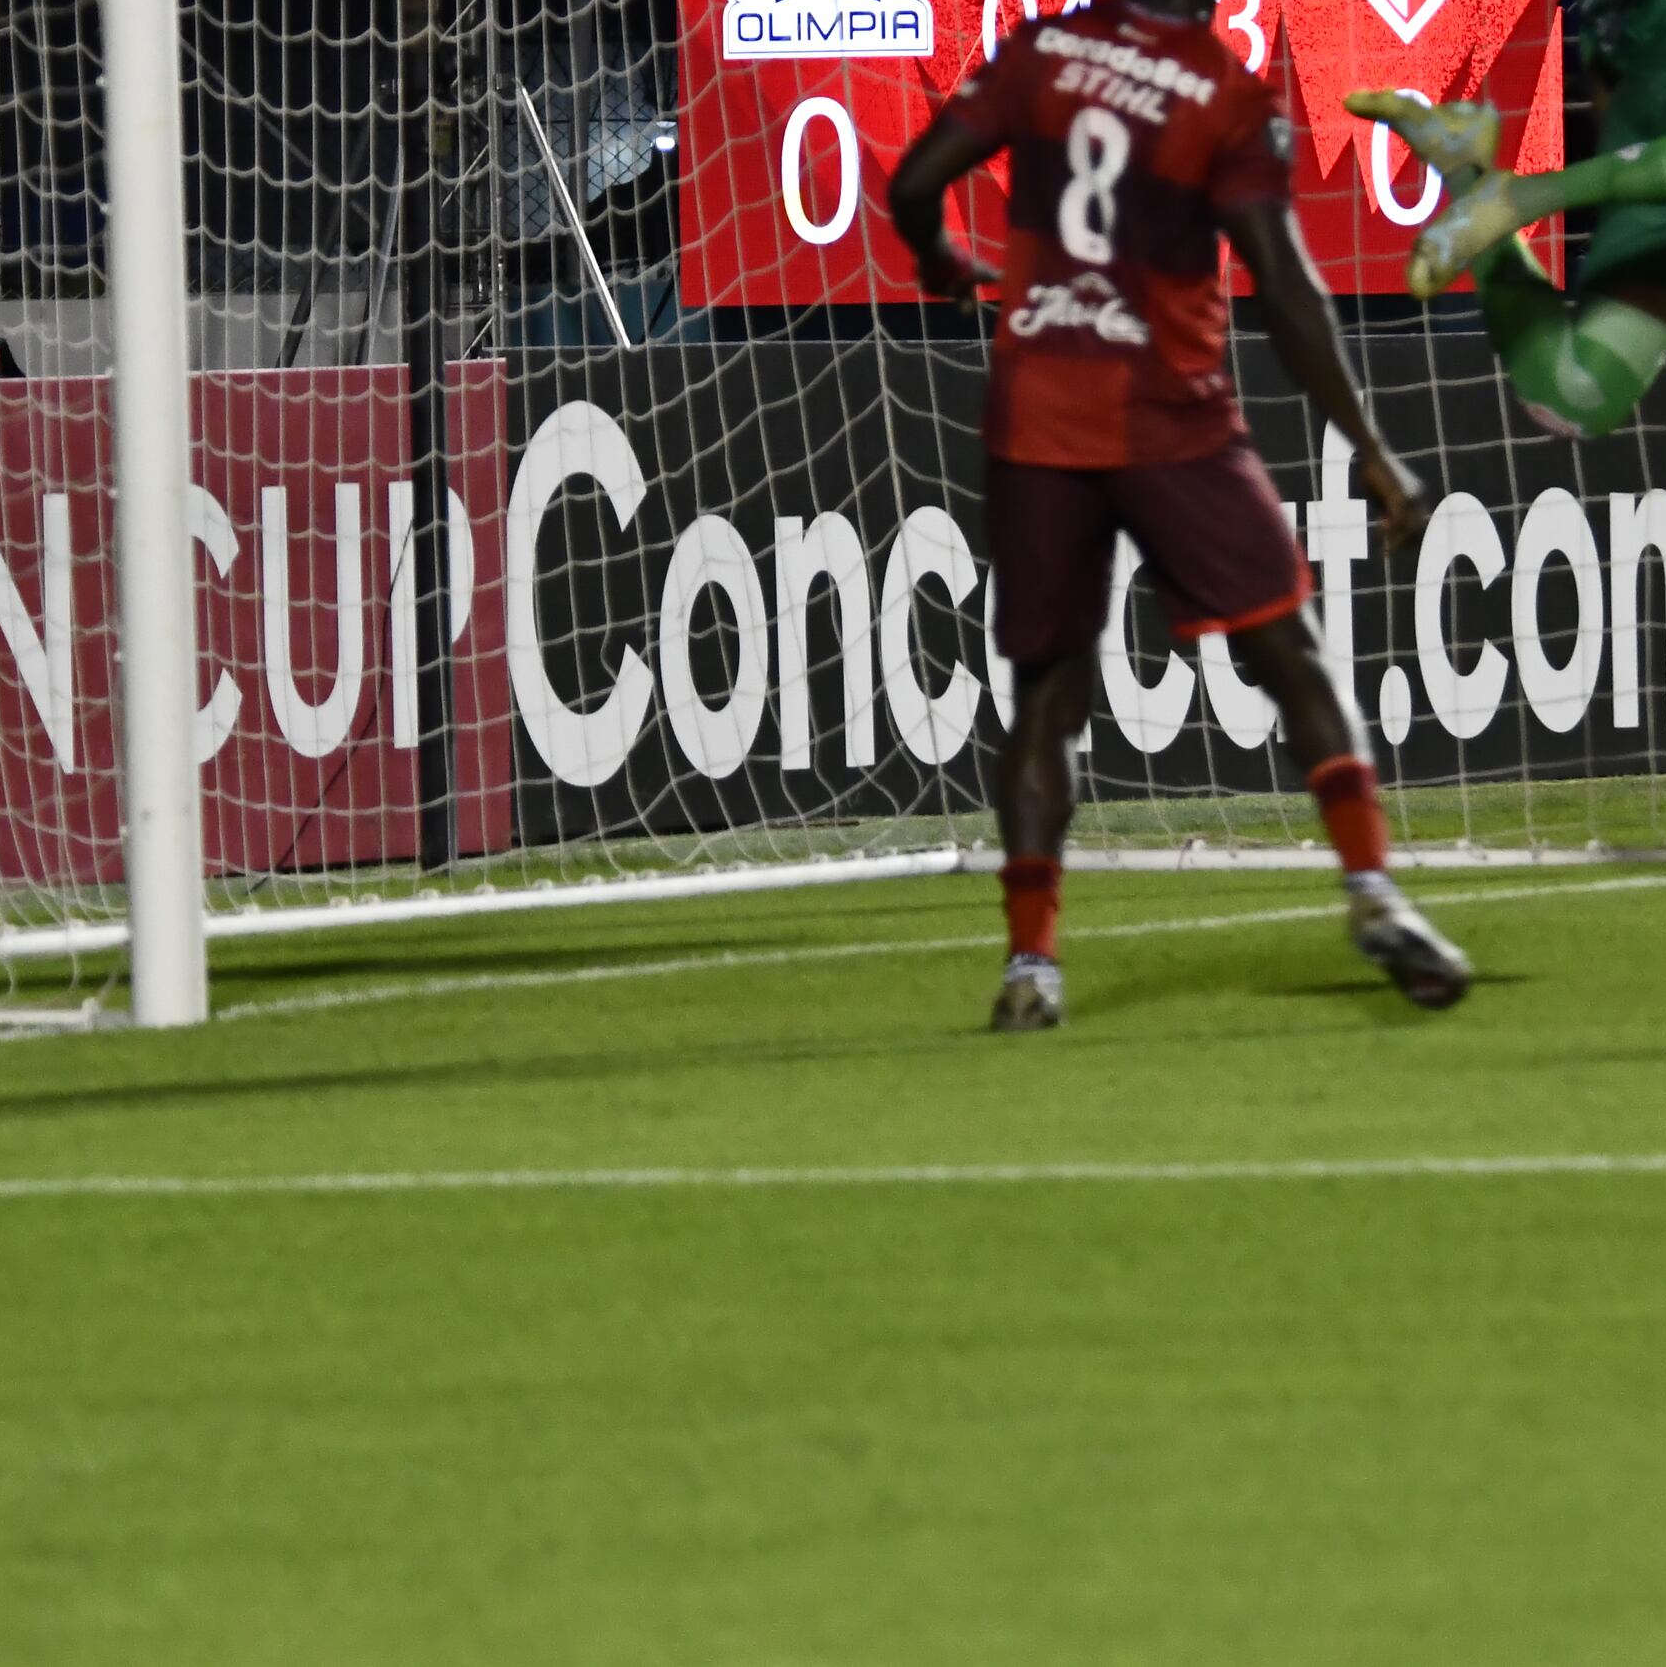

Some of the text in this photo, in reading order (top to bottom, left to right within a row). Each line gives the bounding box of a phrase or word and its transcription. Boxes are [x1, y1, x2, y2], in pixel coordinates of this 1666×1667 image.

[737, 10, 920, 42] OLIMPIA
[781, 97, 859, 244] 0
[1057, 105, 1131, 265] 8
